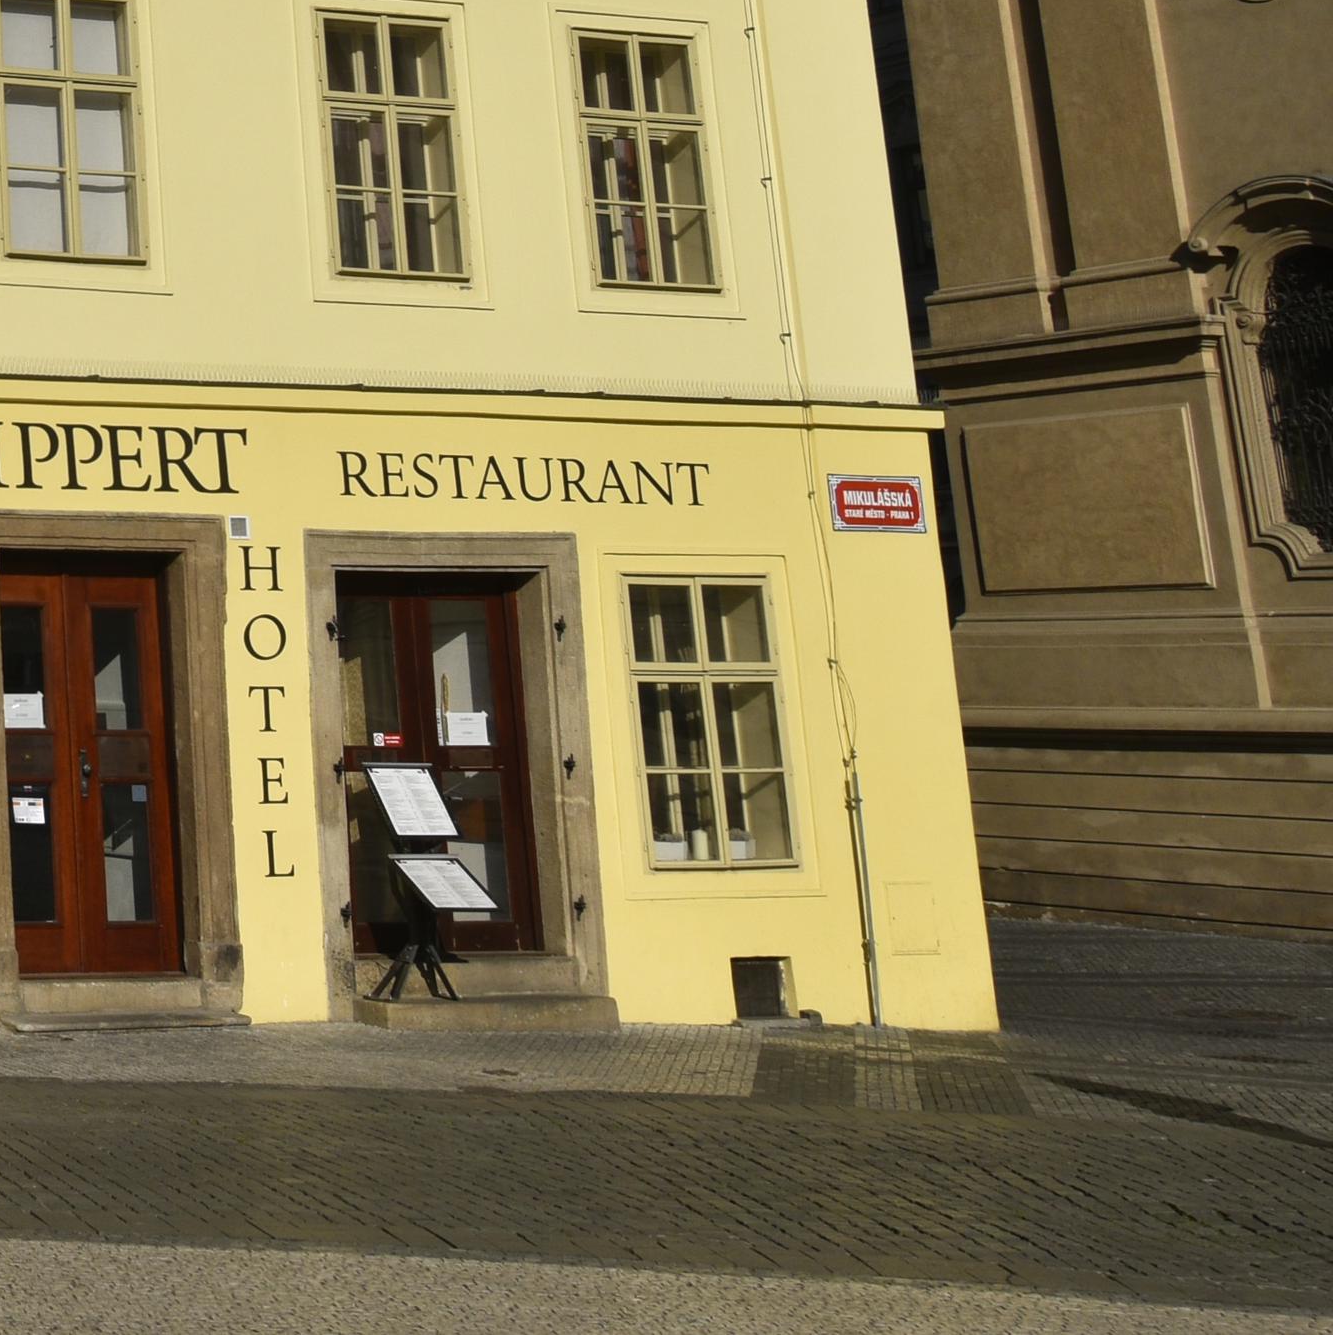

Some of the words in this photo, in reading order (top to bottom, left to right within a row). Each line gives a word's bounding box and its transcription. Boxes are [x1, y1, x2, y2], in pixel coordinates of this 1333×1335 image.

[336, 451, 710, 506] RESTAURANT
[842, 488, 913, 508] MIKULÁŠSKÁ
[238, 545, 296, 879] HOTEL
